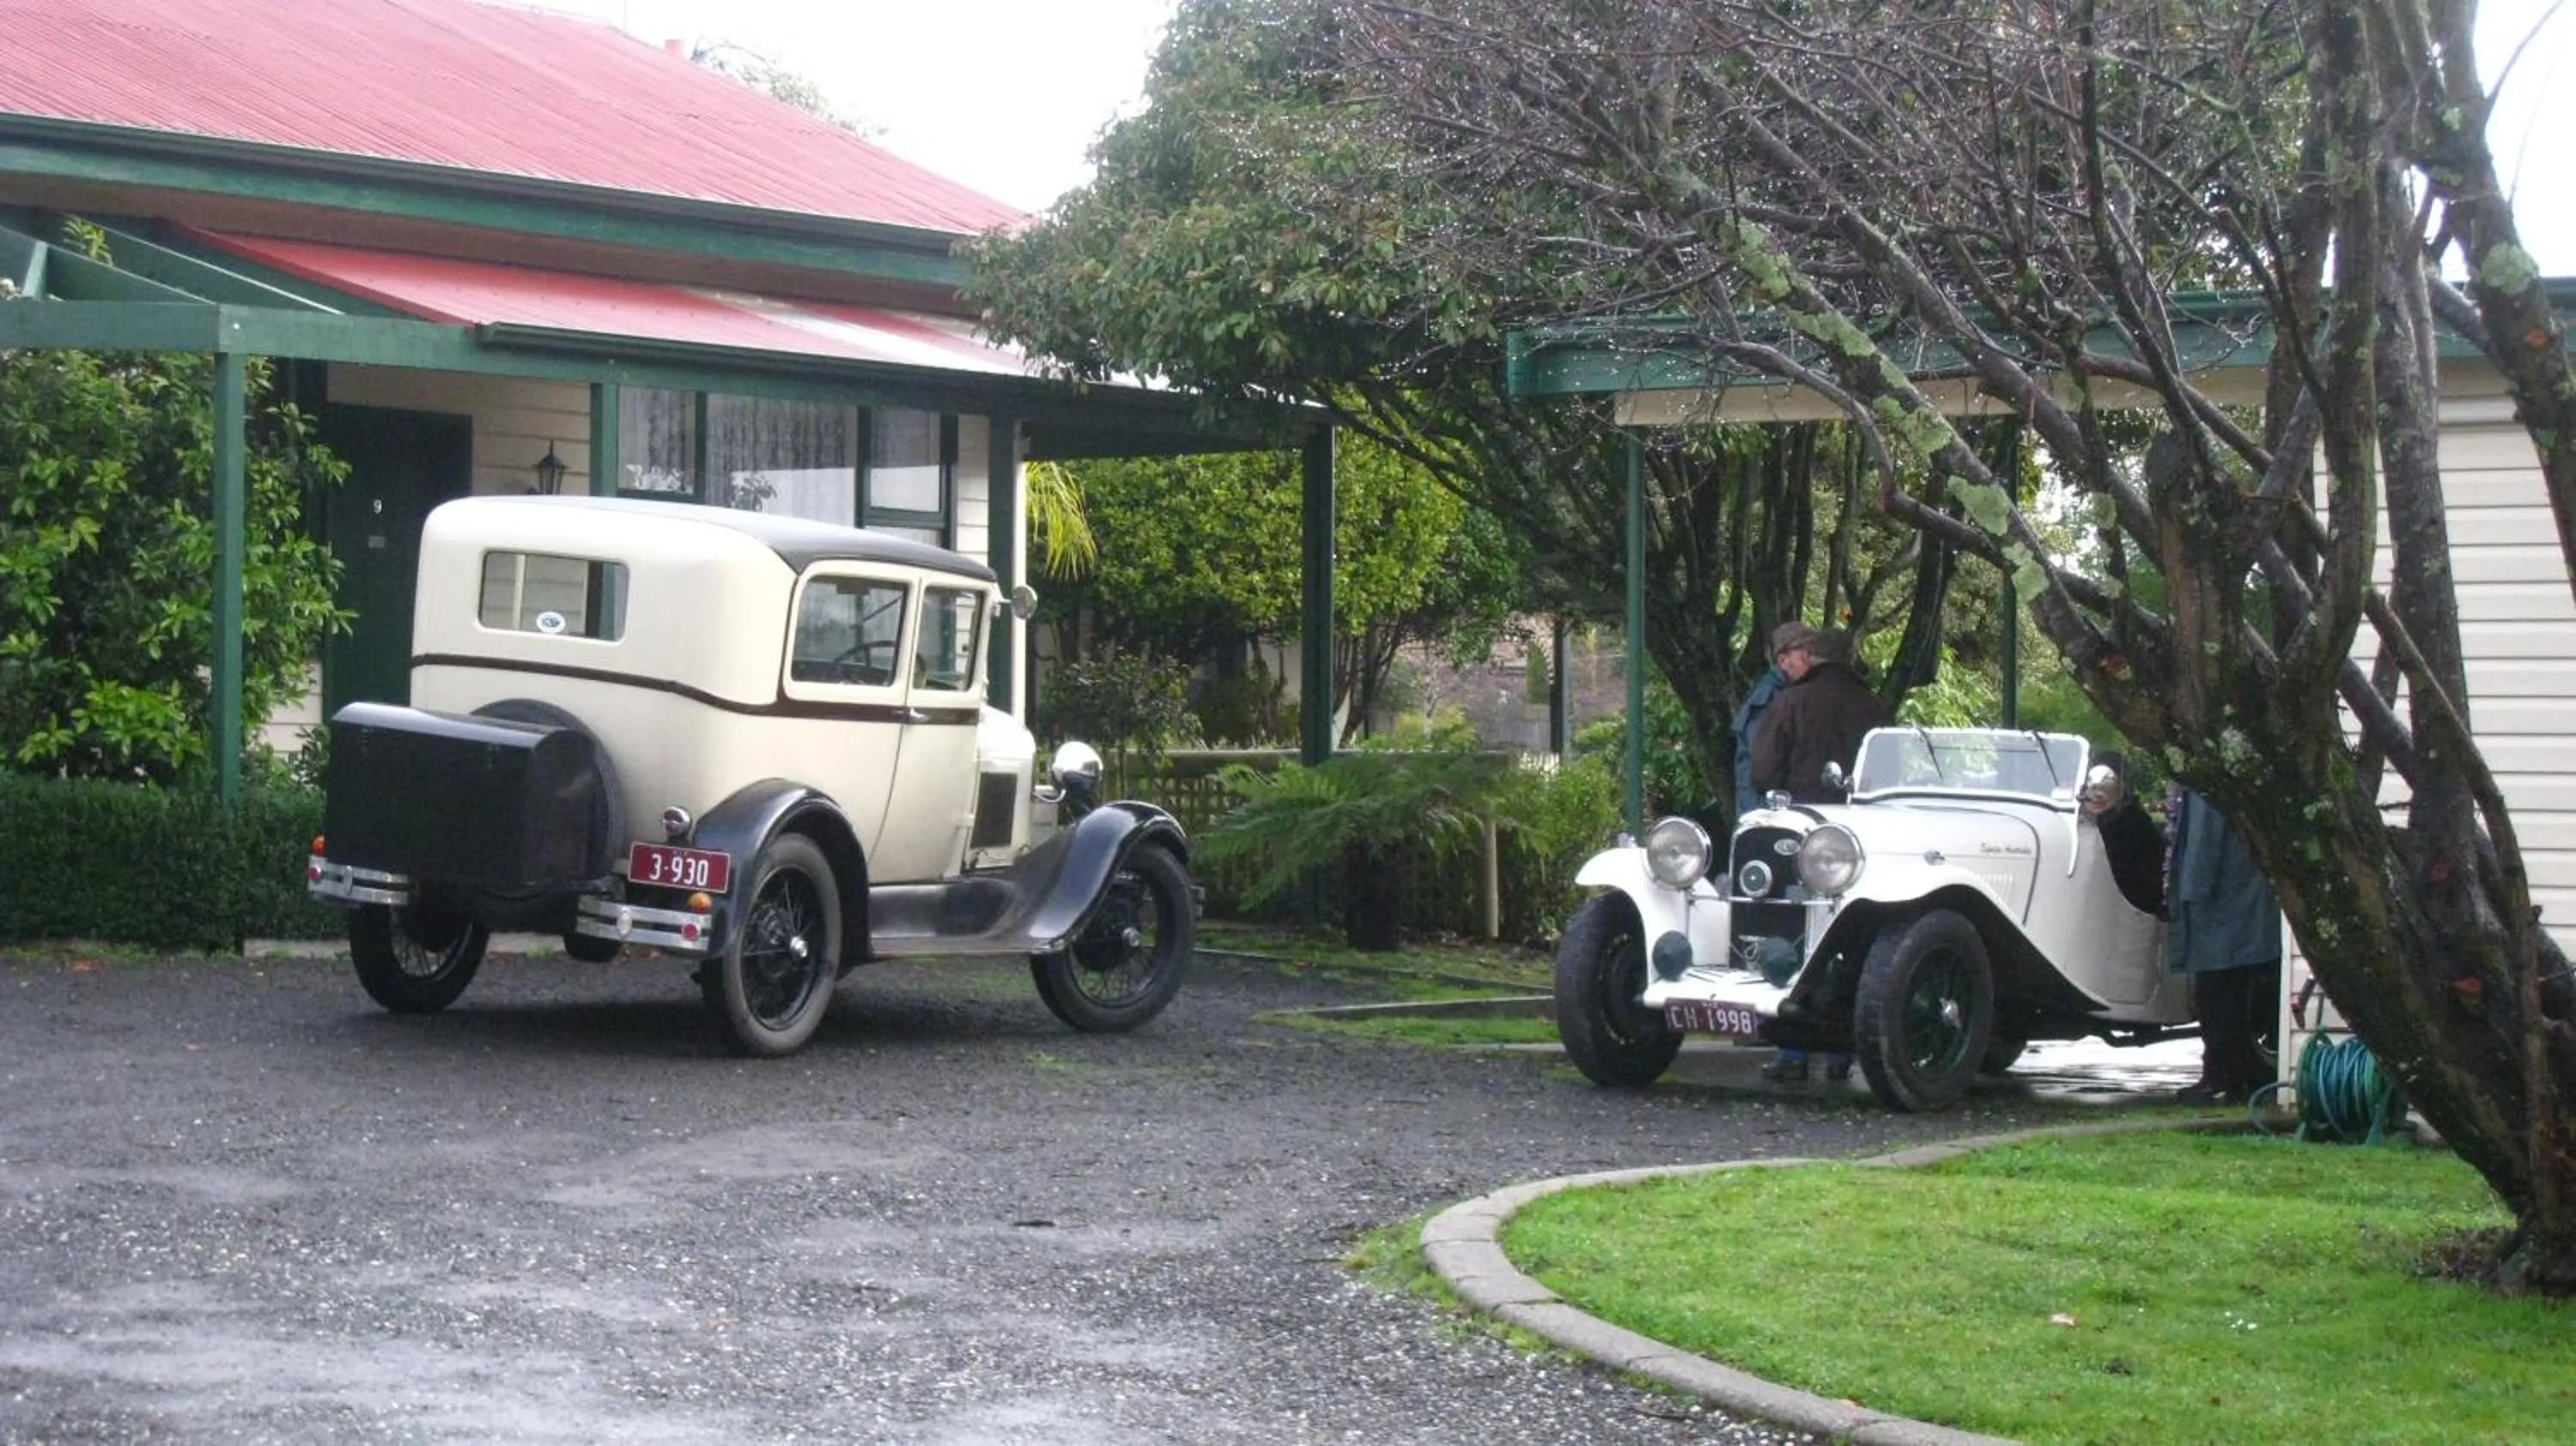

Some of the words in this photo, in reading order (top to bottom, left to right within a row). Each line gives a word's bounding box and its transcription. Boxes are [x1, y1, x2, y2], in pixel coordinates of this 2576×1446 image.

[374, 499, 382, 513] 9
[1670, 1006, 1698, 1030] CH
[1706, 1008, 1752, 1034] 1998
